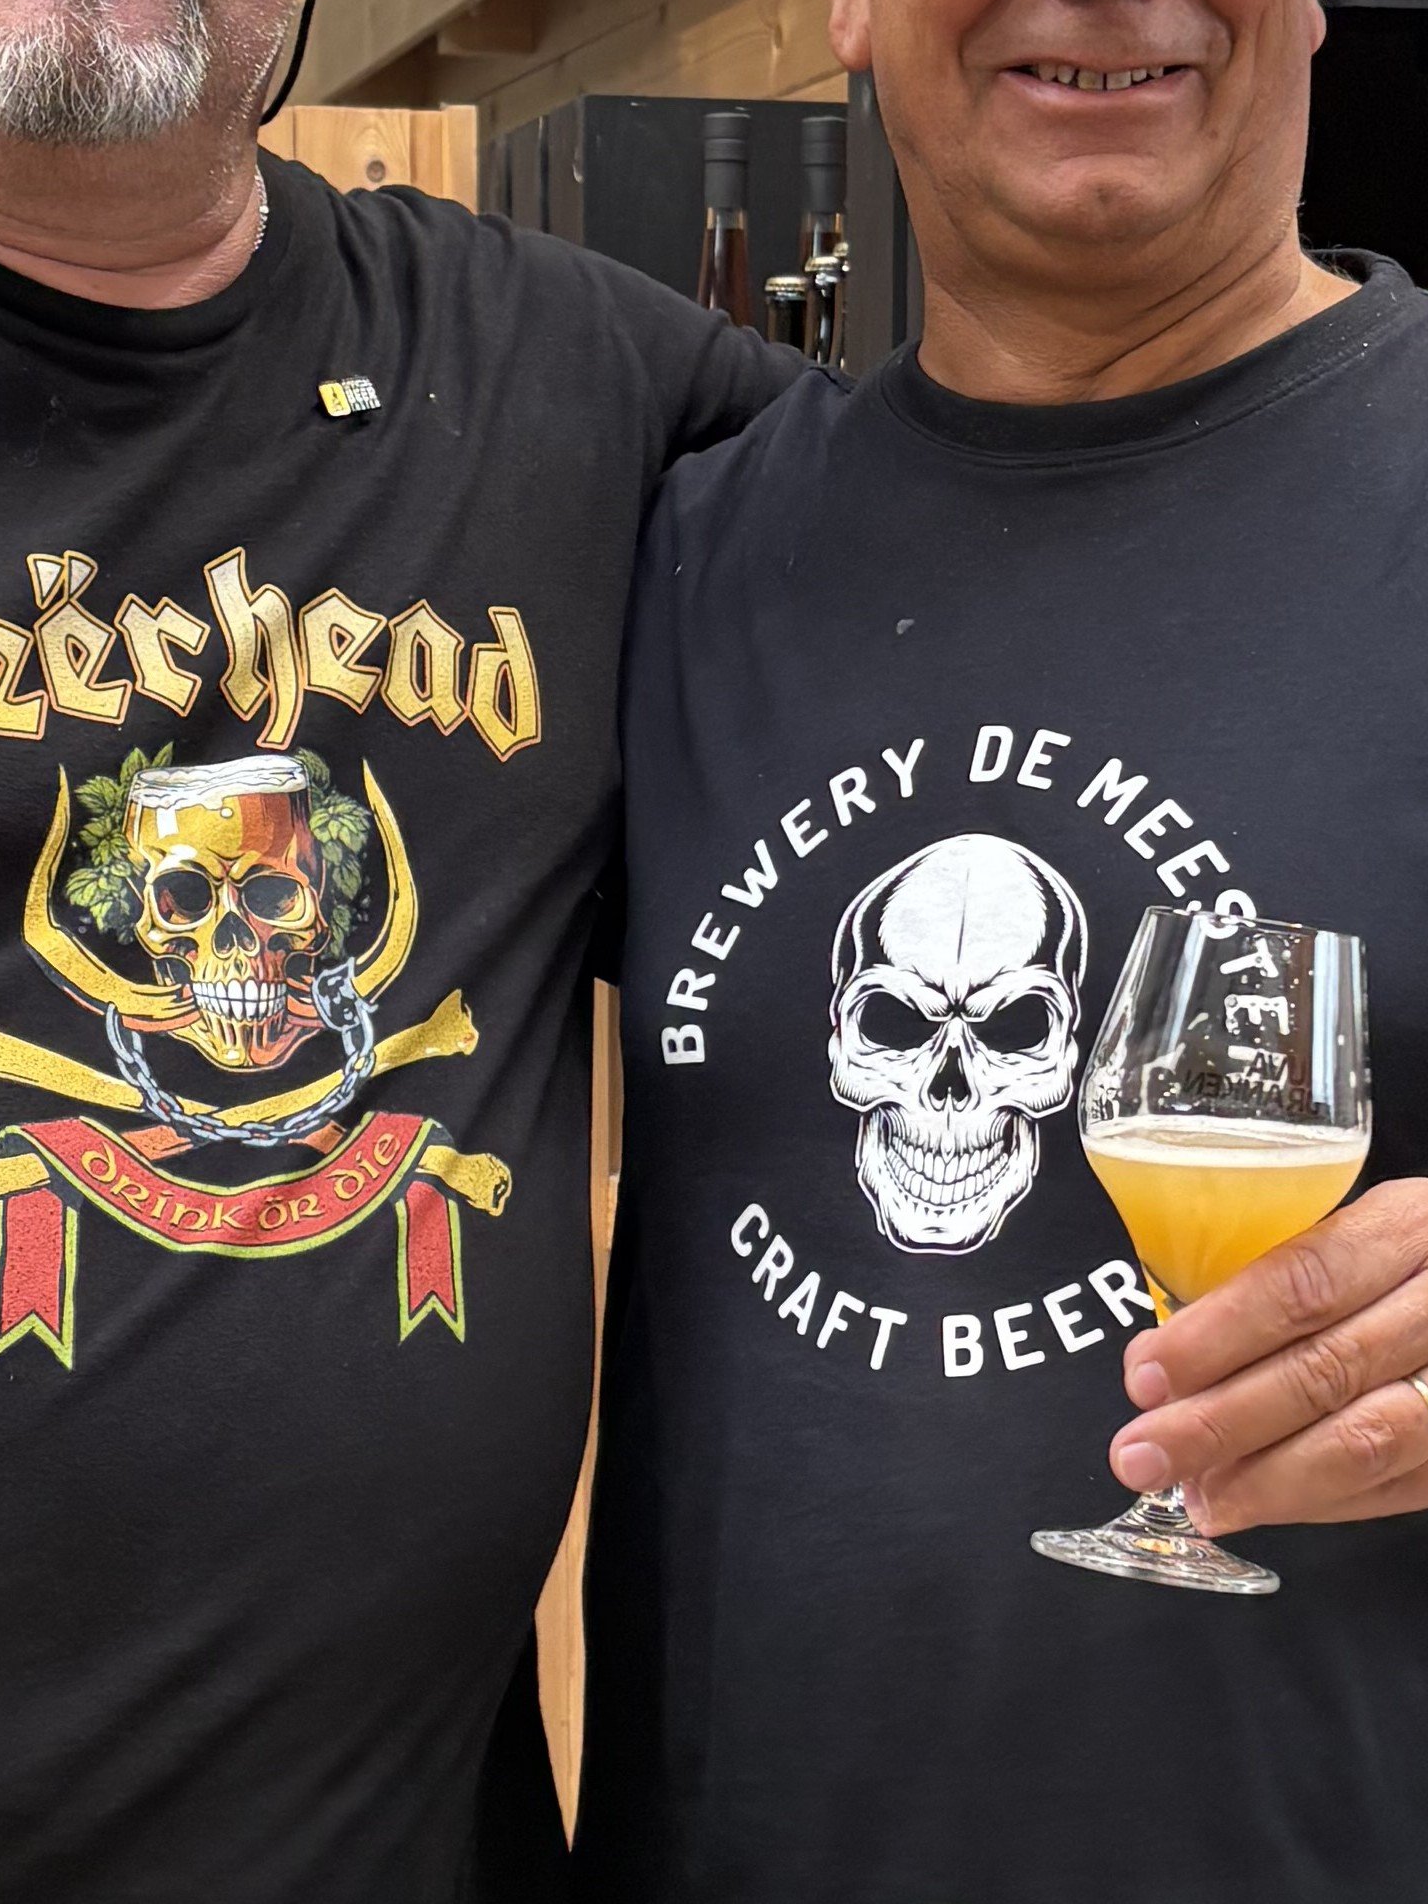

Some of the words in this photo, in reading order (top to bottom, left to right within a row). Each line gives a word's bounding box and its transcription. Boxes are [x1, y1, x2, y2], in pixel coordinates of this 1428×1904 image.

[661, 738, 925, 1065] BREWERY
[969, 724, 1072, 790] DE
[327, 1132, 401, 1200] die
[730, 1201, 908, 1371] CRAFT
